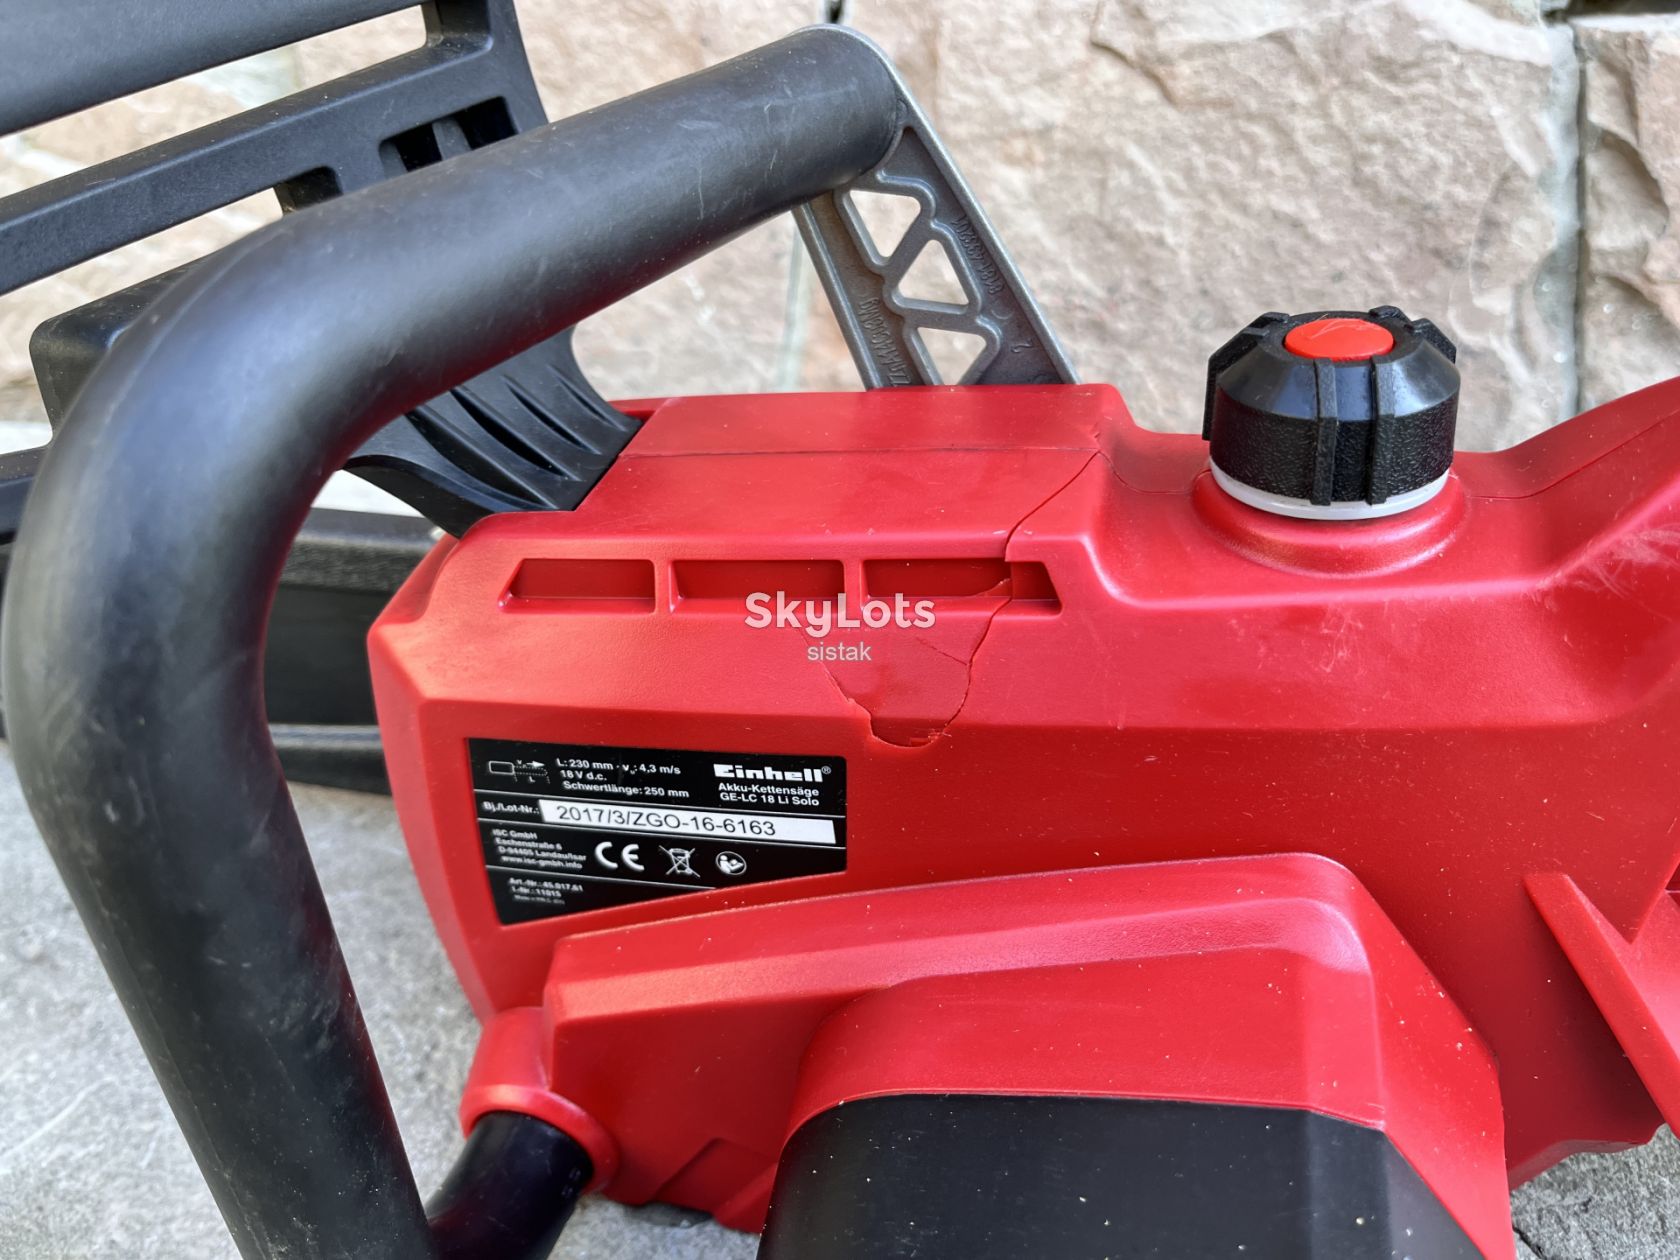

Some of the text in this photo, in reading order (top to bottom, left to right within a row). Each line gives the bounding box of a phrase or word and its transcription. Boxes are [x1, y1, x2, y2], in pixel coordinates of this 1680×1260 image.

[560, 769, 608, 781] 18 V d.c.
[569, 759, 590, 769] 230
[592, 762, 614, 771] mm
[660, 765, 681, 775] m/s
[562, 780, 690, 799] Schwertlänge: 250 mm
[718, 782, 820, 798] Akku-Kettensäge
[719, 792, 820, 806] GE-LC 18 Li Solo
[556, 805, 776, 836] 2017/3/ZGO-16-6163
